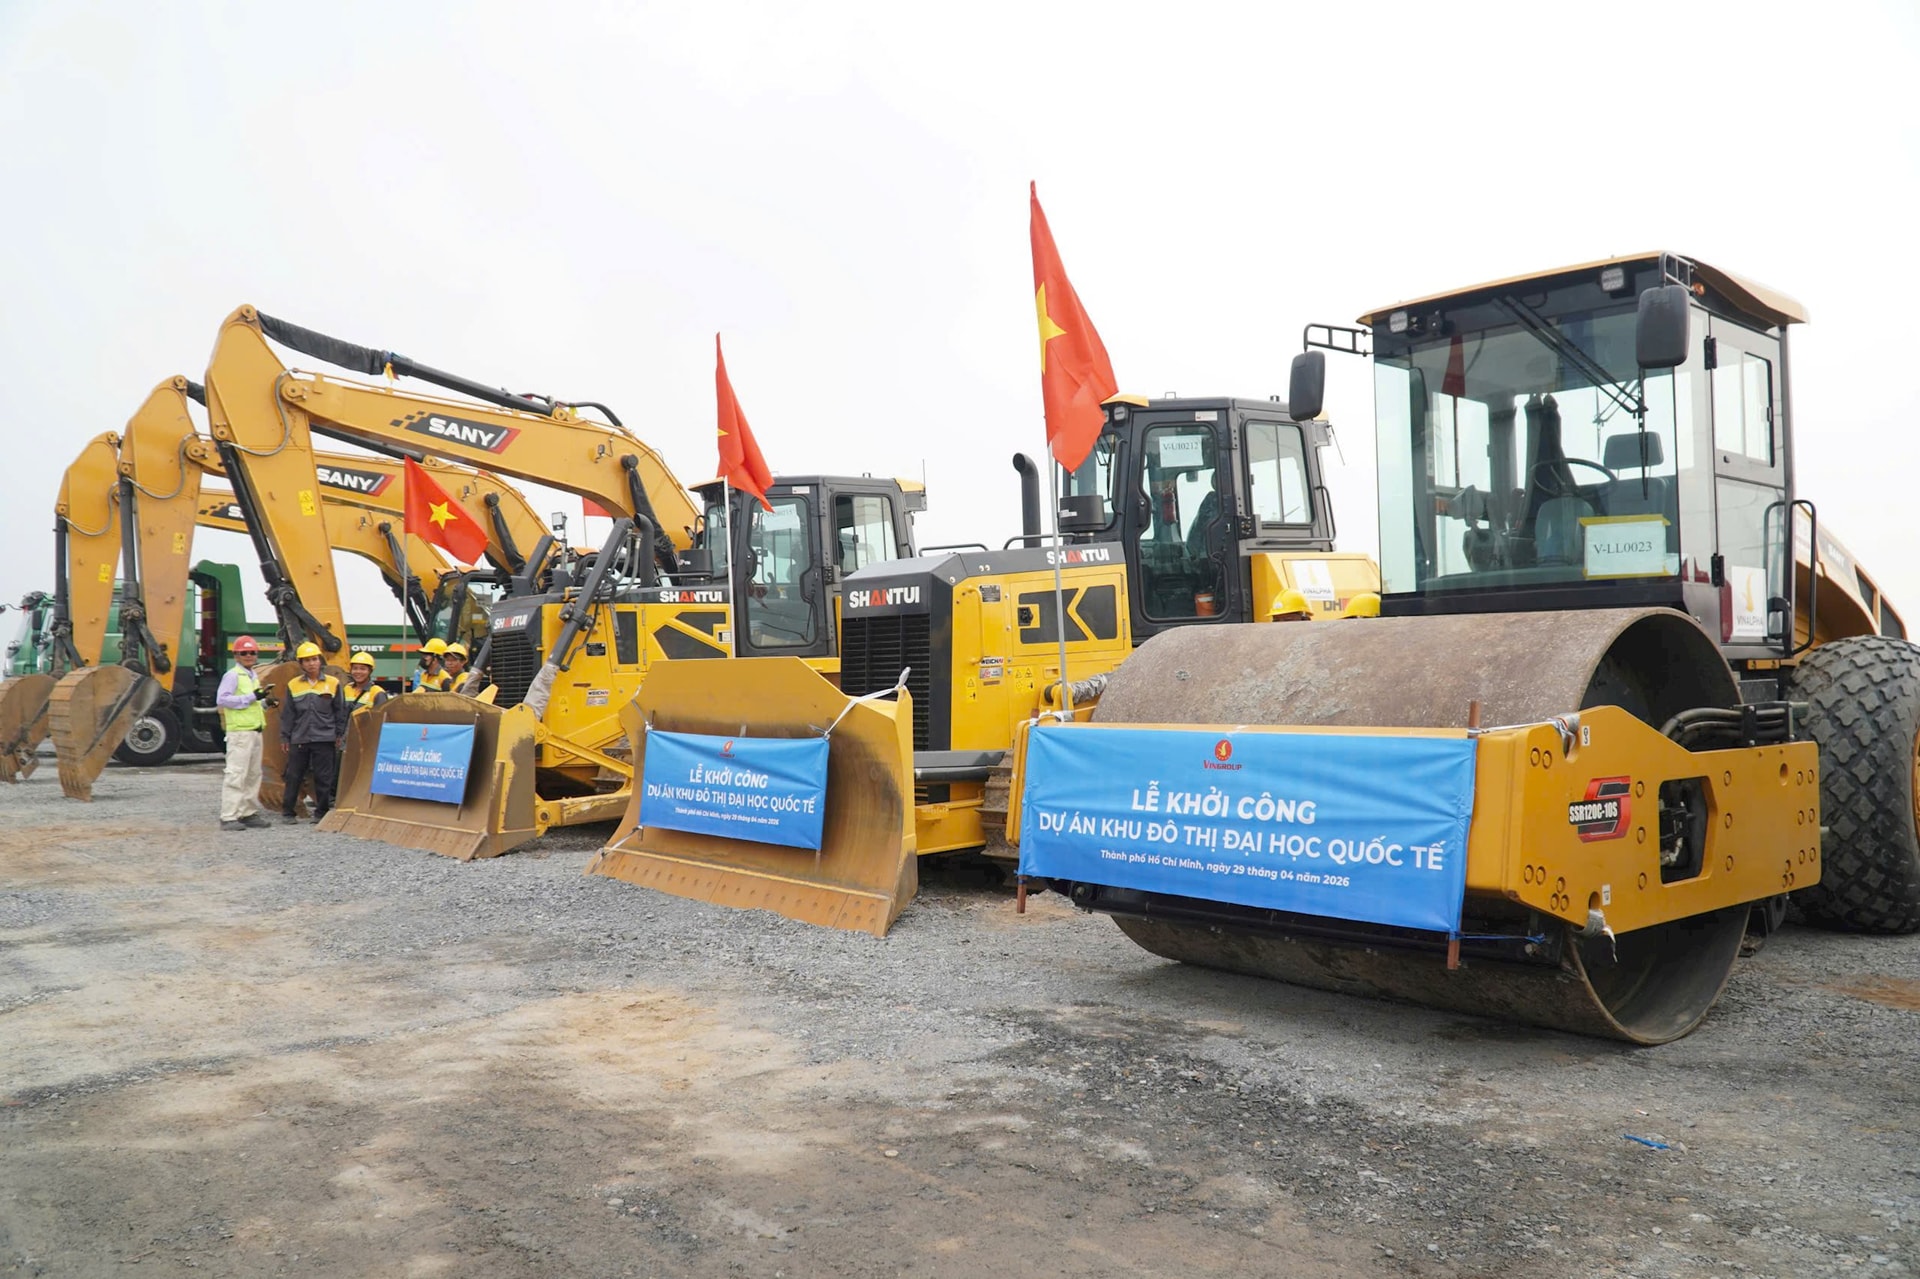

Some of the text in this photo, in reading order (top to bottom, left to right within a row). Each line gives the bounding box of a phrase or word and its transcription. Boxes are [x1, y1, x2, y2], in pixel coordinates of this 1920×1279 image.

[428, 417, 495, 447] SANY
[317, 467, 373, 491] SANY
[1046, 548, 1110, 564] SHANTUI
[1593, 541, 1653, 554] V-LL0023
[660, 590, 722, 603] SHANTUI
[849, 586, 920, 608] SHANTUI
[690, 763, 768, 789] LỄ KHỞI CÔNG
[1203, 760, 1243, 771] VINGROUP
[648, 783, 817, 814] DỰ ÁN KHU ĐÔ THỊ ĐẠI HỌC QUỐC TẾ
[1131, 780, 1317, 825] LỄ KHỞI CÔNG
[1569, 801, 1618, 823] SSR120C-10S
[1039, 811, 1446, 871] DỰ ÁN KHU ĐÔ THỊ ĐẠI HỌC QUỐC TẾ
[1100, 850, 1350, 887] Thành phố Hồ Chí Minh, ngày 29 tháng 04 năm 2026
